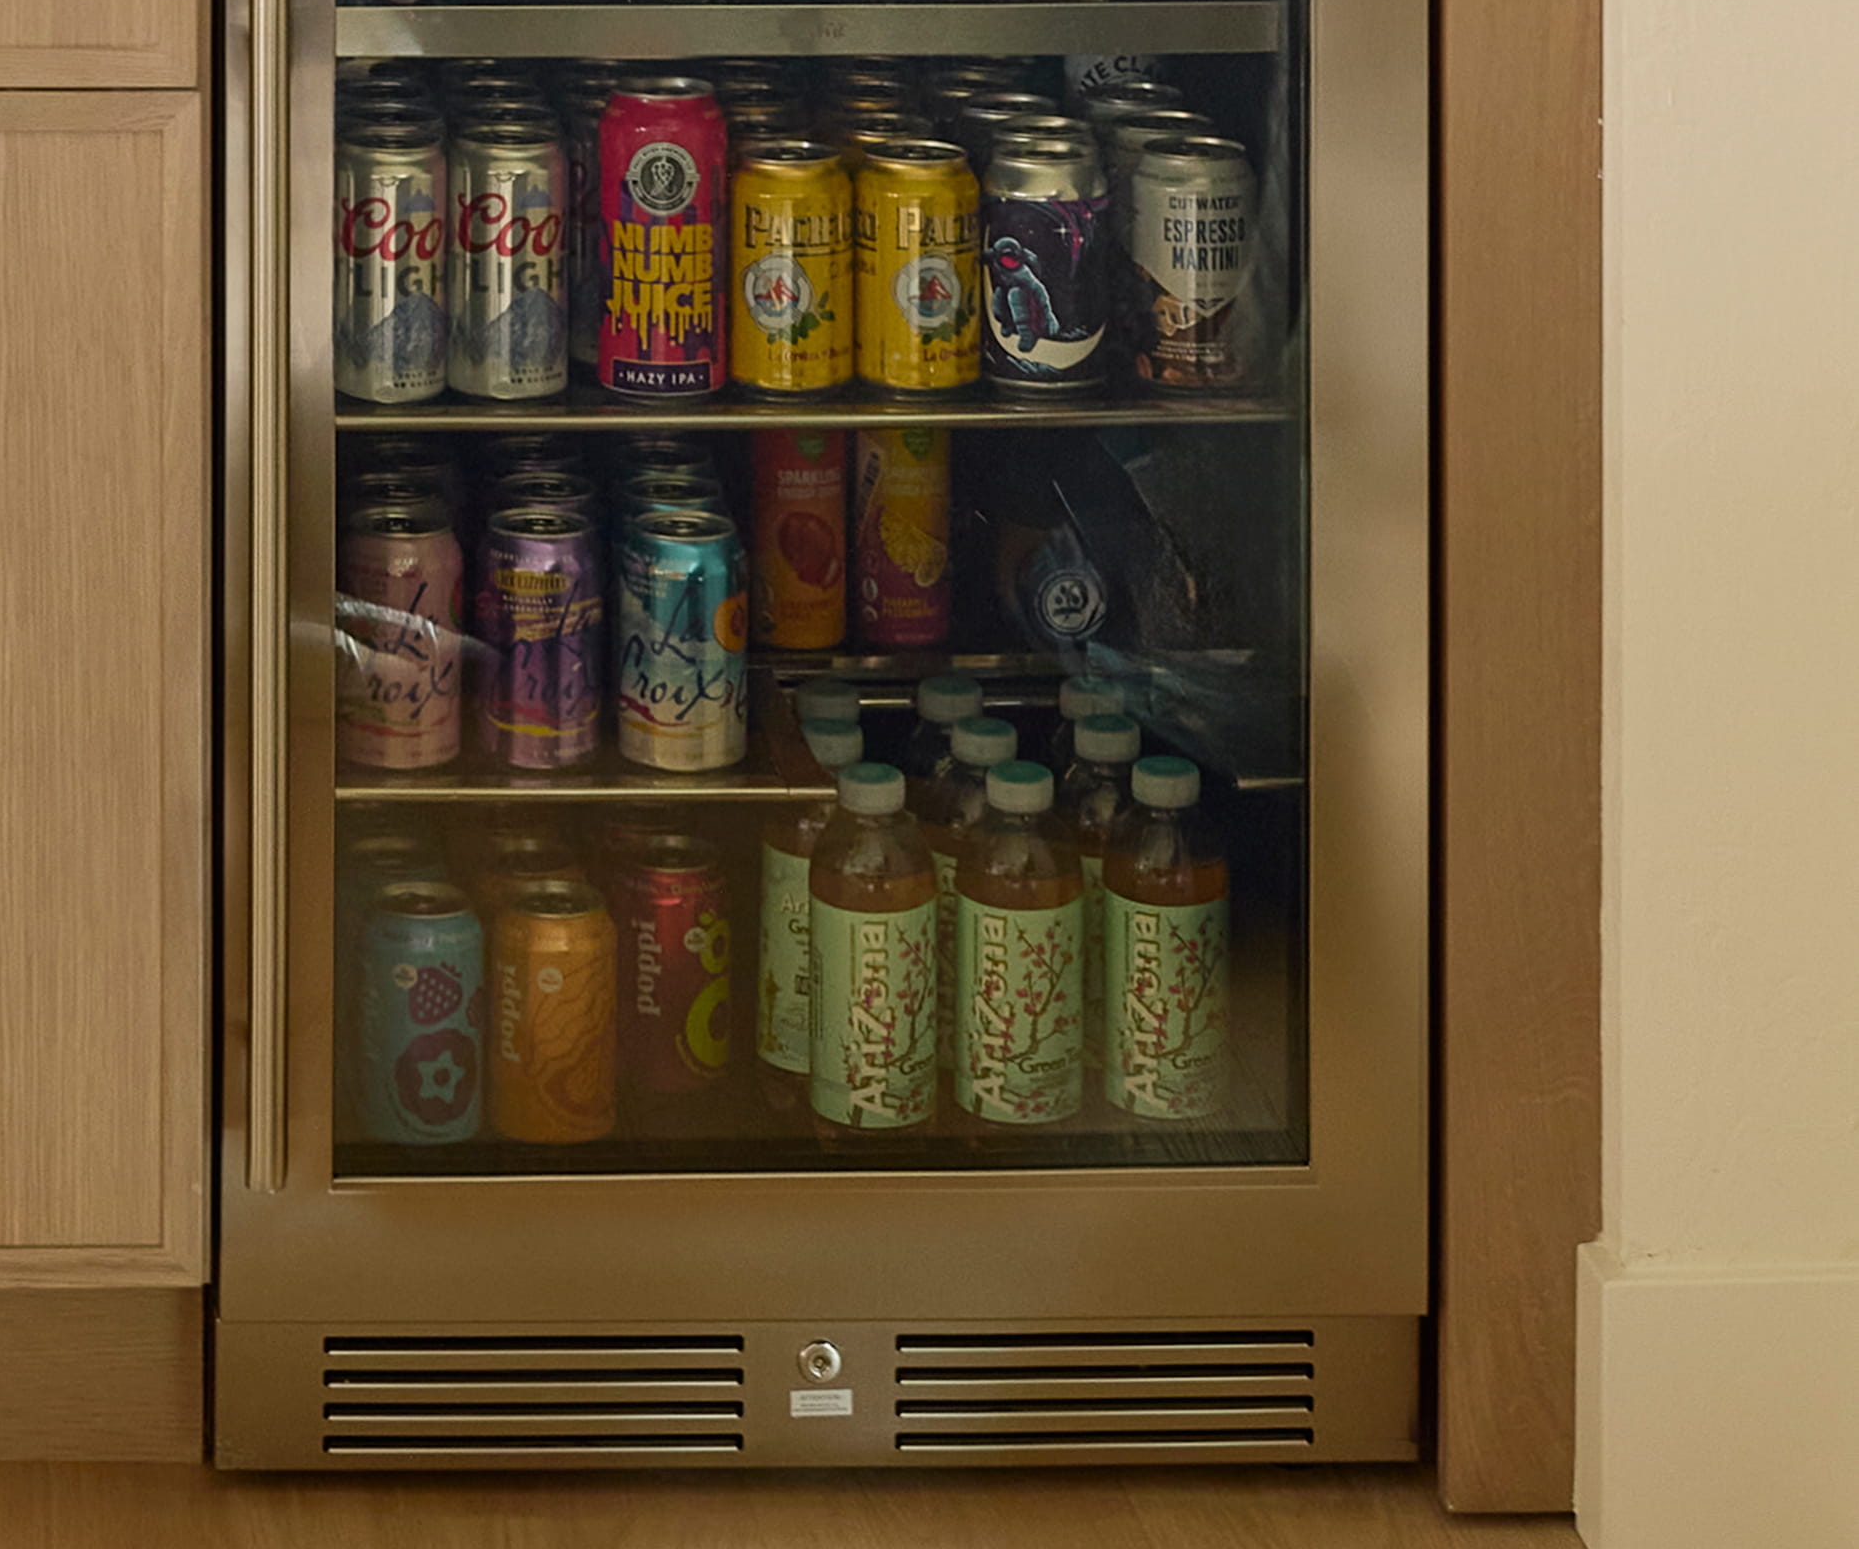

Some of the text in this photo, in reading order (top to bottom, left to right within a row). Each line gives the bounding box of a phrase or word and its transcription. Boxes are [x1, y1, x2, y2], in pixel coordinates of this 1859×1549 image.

[457, 193, 564, 257] Coo
[613, 220, 714, 254] NUMB
[1163, 217, 1246, 244] ESPRESSO
[613, 251, 713, 283] NUMB
[1171, 246, 1239, 272] MARTINI
[606, 278, 712, 329] JUICE
[626, 371, 696, 386] HAZY IPA
[631, 918, 661, 1017] poppi
[498, 961, 521, 1062] poppi
